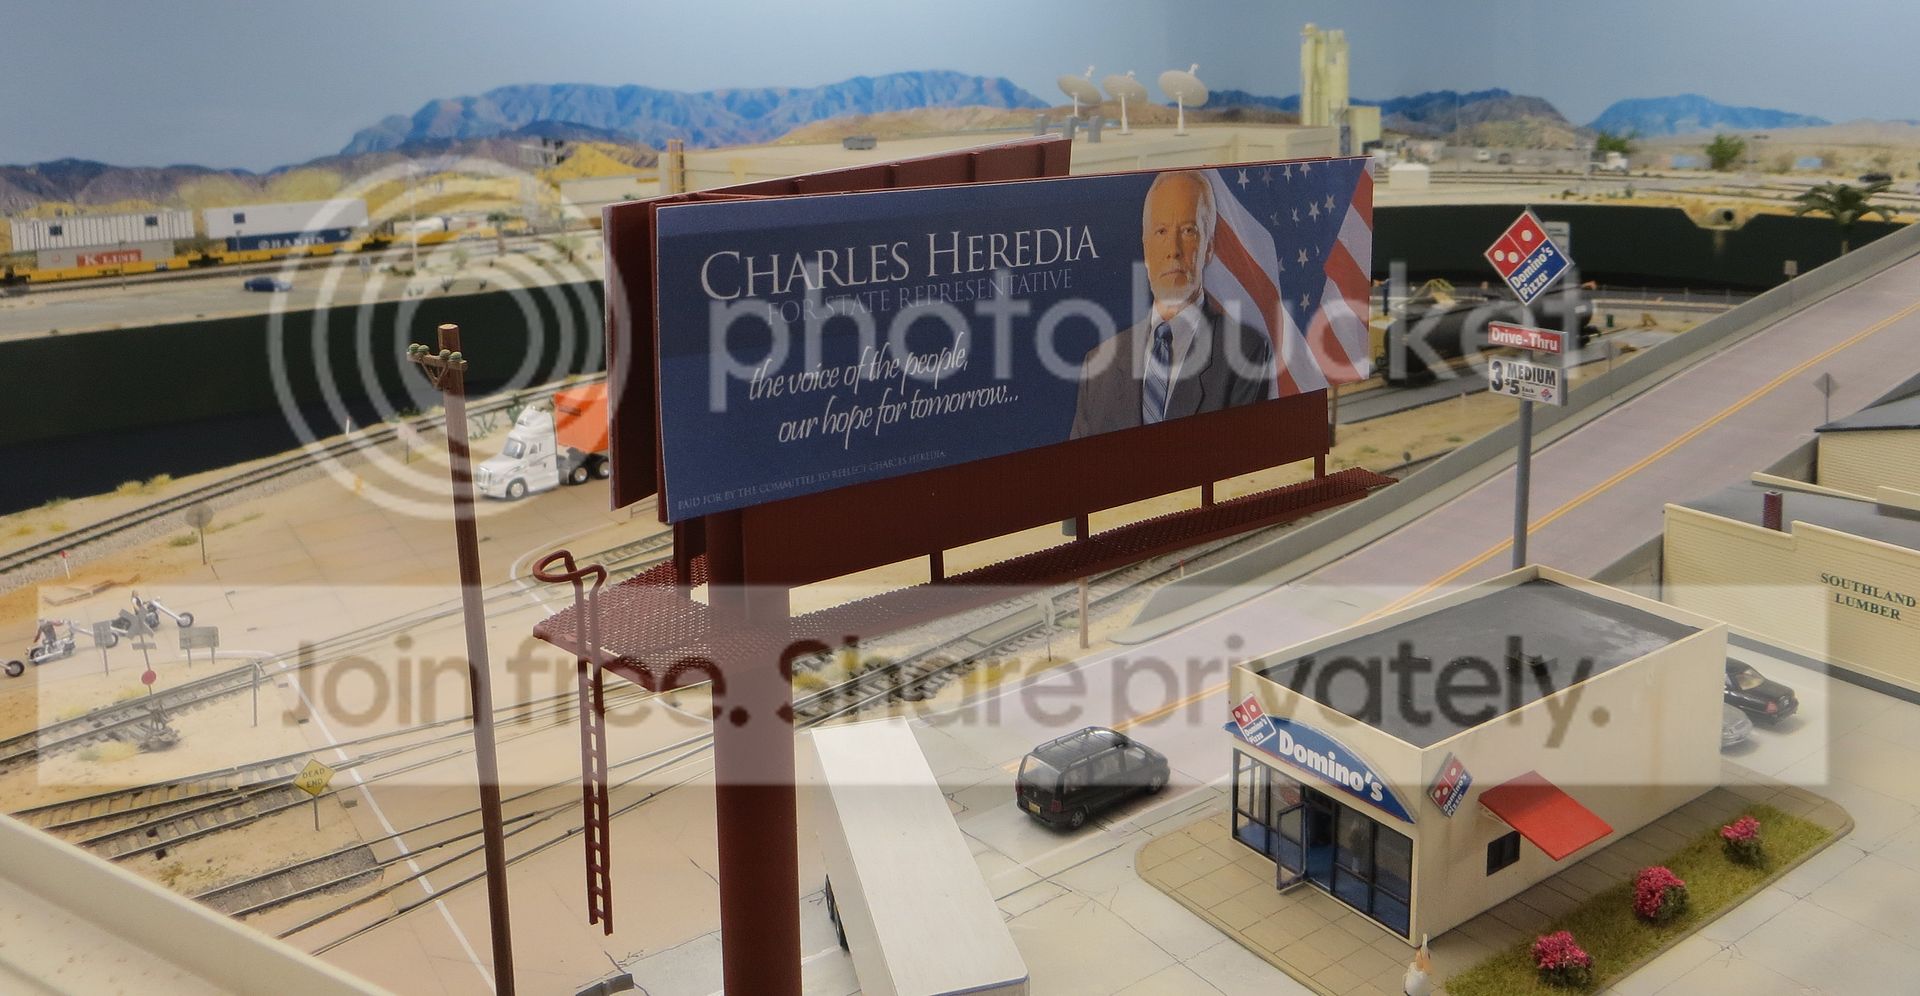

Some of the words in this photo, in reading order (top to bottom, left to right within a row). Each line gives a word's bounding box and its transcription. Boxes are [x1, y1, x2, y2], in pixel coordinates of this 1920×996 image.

[1509, 247, 1554, 288] Domino's
[767, 299, 823, 325] FOR
[824, 287, 891, 318] STATE
[899, 267, 1073, 307] REPRESENTATIVE
[1519, 272, 1549, 300] Pizza
[1491, 327, 1558, 352] Drive-Thru
[749, 357, 785, 400] the
[788, 363, 840, 395] voice
[843, 344, 873, 395] of
[868, 341, 900, 381] the
[900, 331, 968, 396] people,
[1491, 360, 1504, 392] 3
[1507, 362, 1556, 386] MEDIUM
[778, 415, 820, 443] our
[821, 394, 874, 450] hope
[874, 387, 907, 436] for
[909, 384, 1019, 421] tomorrow...
[1820, 572, 1917, 609] SOUTHLAND
[1835, 592, 1902, 621] LUMBER
[302, 767, 325, 779] DEAD
[1279, 728, 1383, 802] Domino's
[306, 778, 323, 788] END
